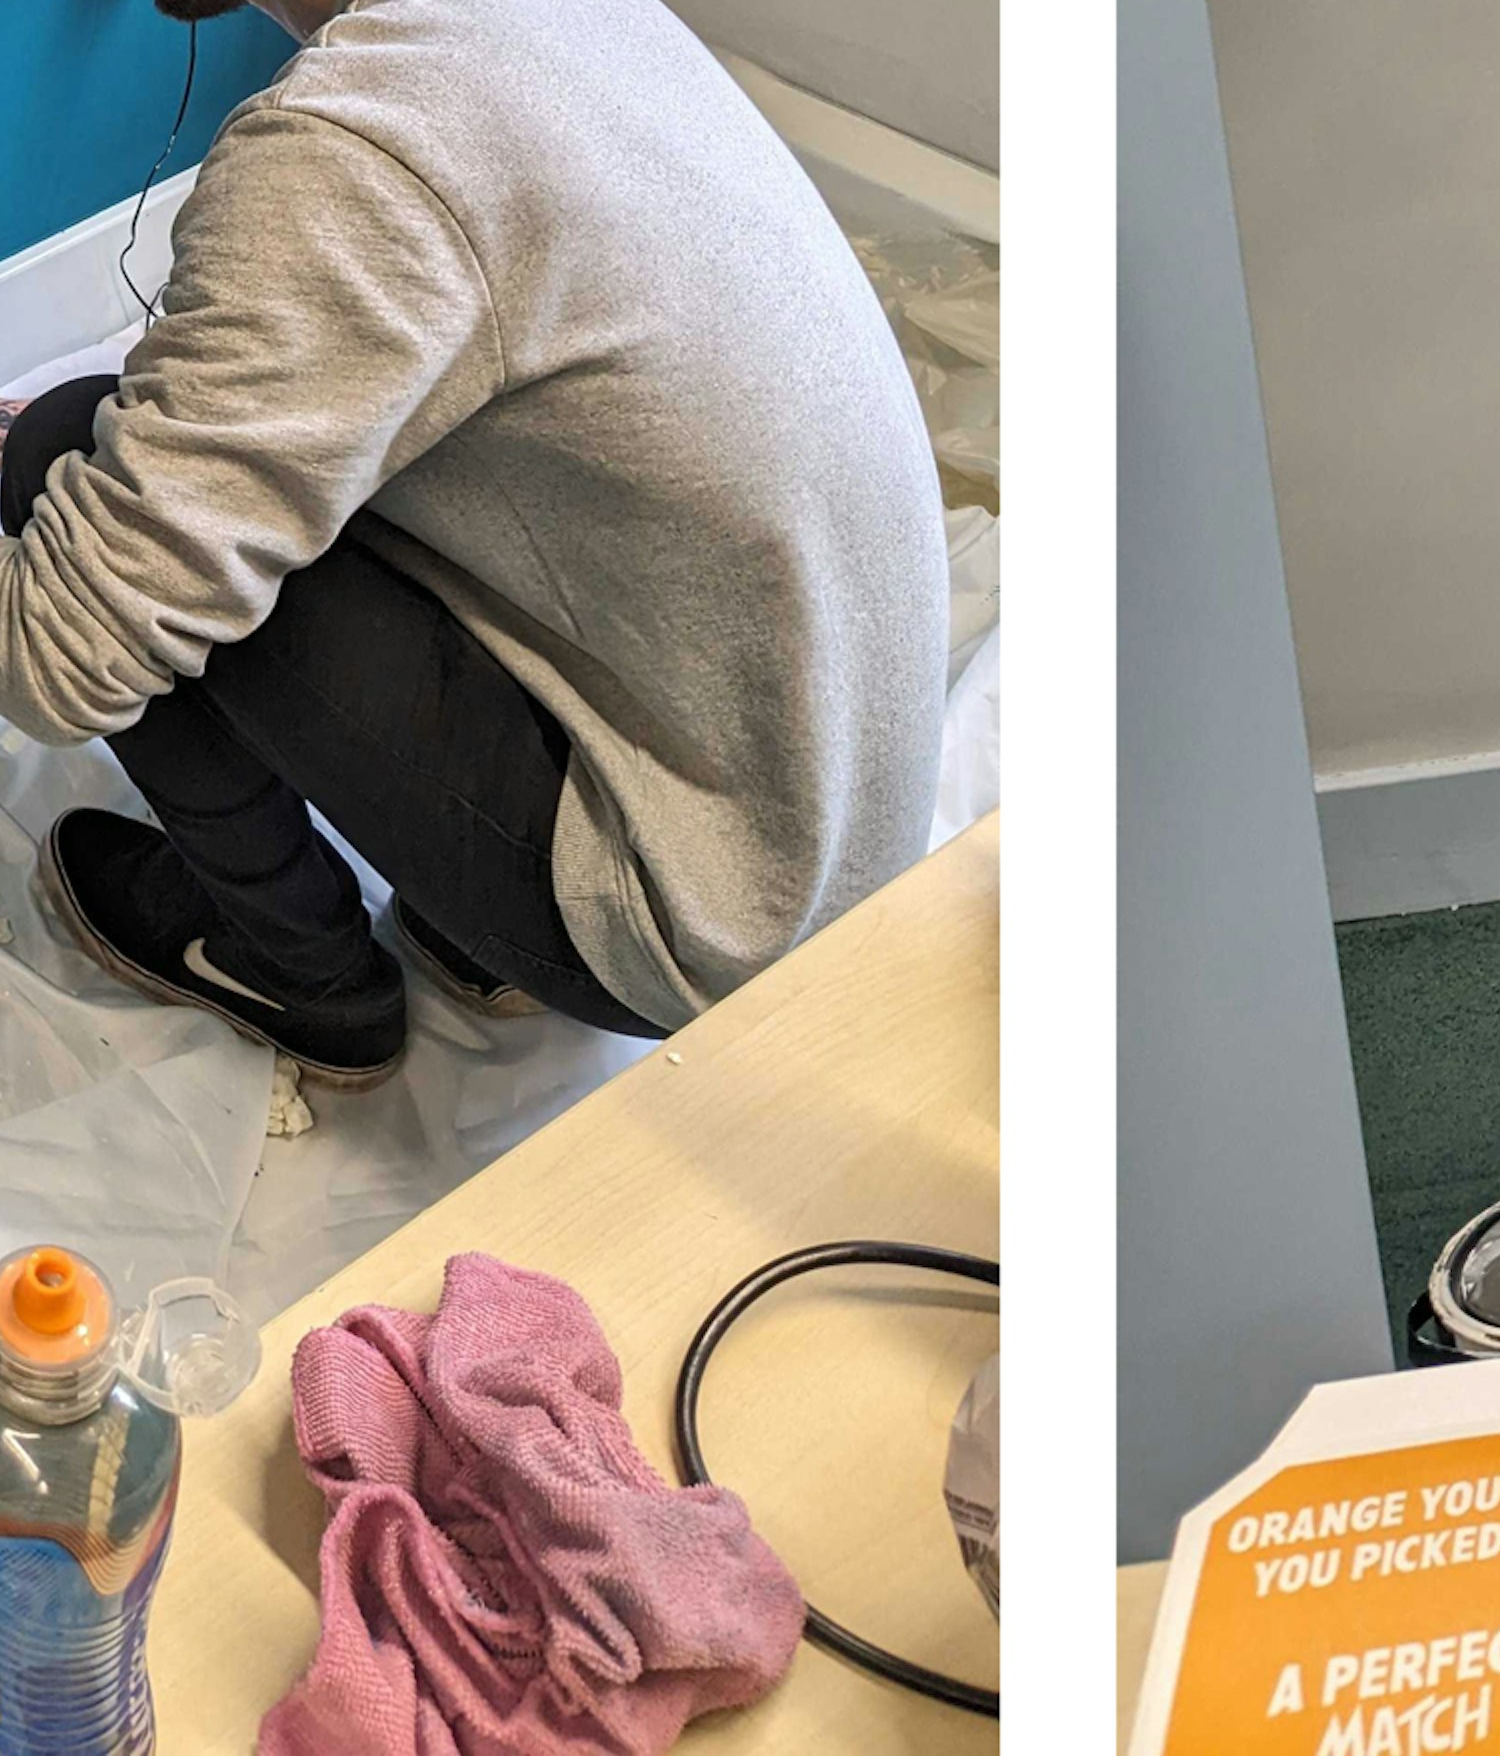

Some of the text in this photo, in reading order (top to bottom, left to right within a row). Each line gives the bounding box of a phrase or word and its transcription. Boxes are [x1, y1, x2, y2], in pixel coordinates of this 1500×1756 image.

[1227, 1491, 1406, 1553] ORANGE
[1254, 1549, 1340, 1598] YOU
[1267, 1663, 1304, 1718] A
[1314, 1684, 1492, 1756] MATCH
